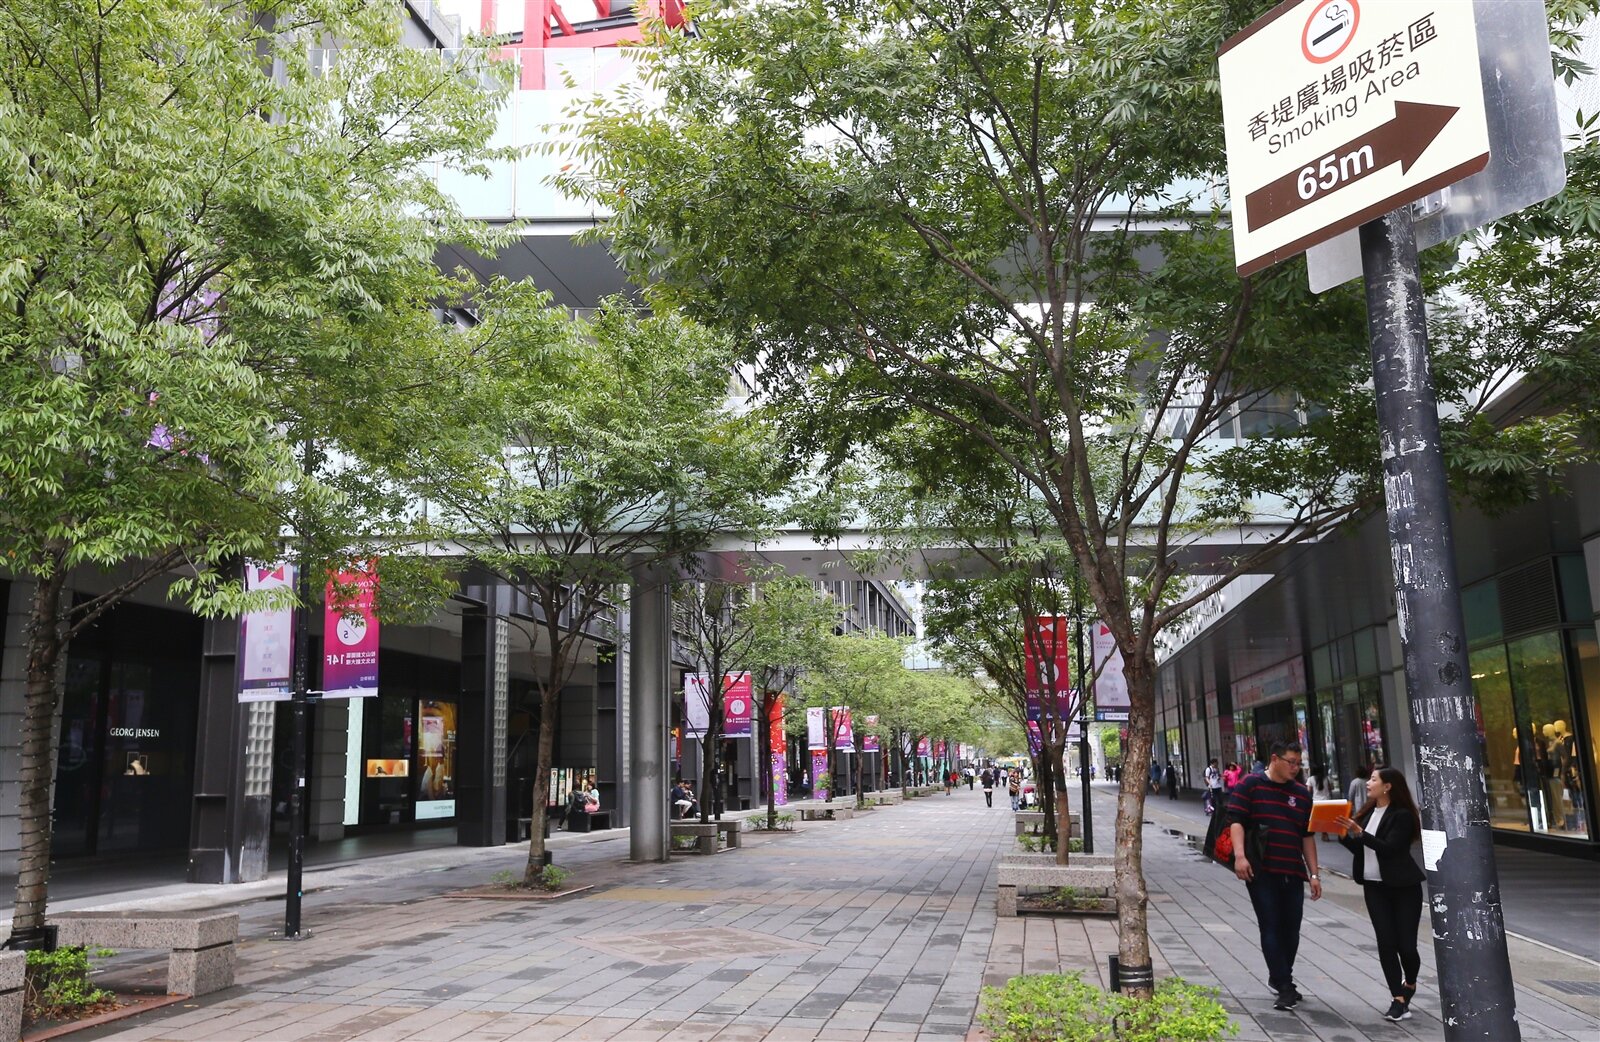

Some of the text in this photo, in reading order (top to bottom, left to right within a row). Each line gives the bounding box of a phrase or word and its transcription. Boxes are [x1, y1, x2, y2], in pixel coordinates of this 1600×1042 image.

[1247, 11, 1438, 142] 香堤廣場吸菸區
[1268, 61, 1420, 155] Smoking Area
[1296, 144, 1375, 200] 65m
[109, 727, 160, 738] GEORG JENSEN
